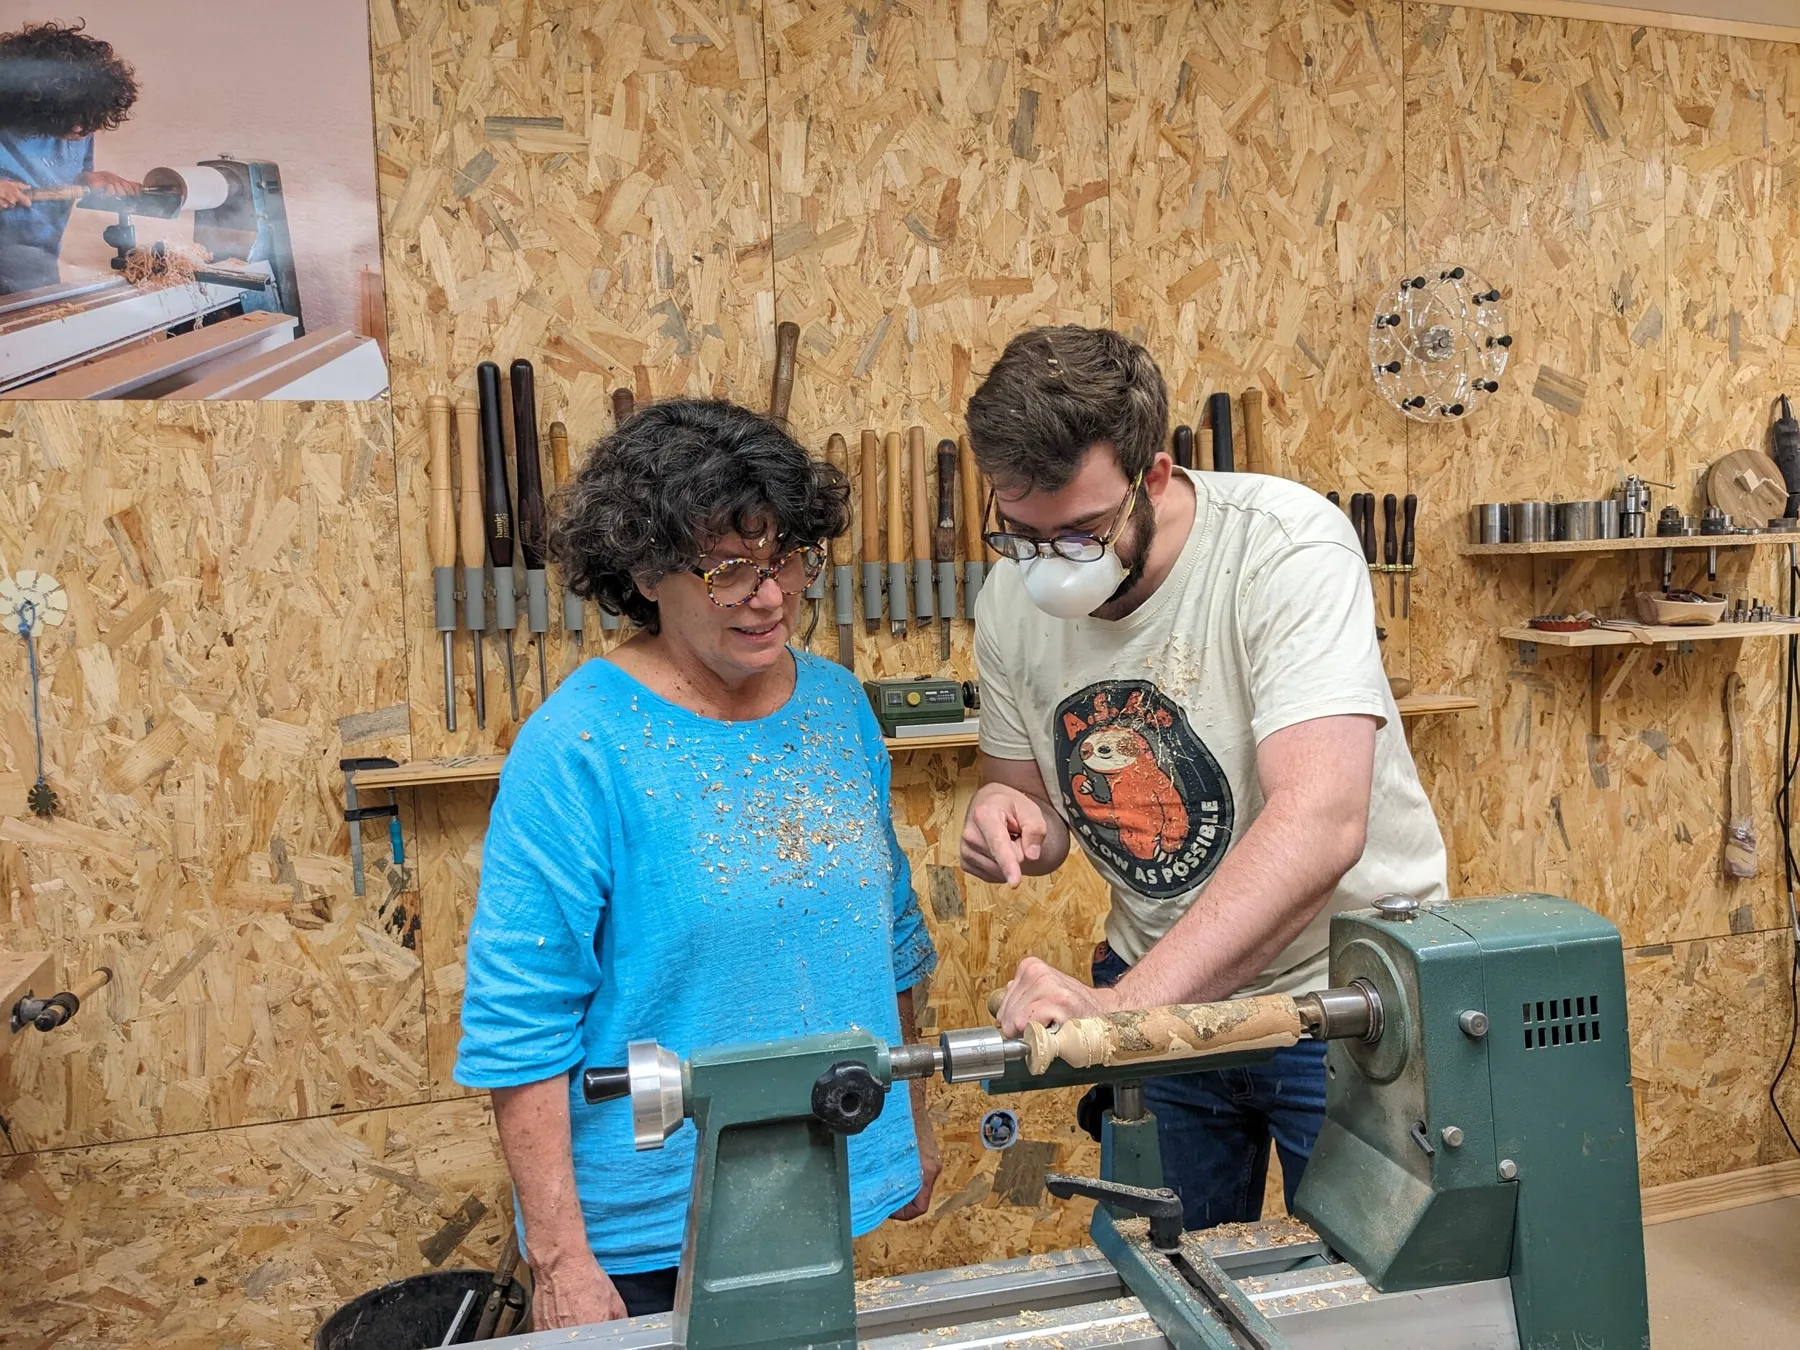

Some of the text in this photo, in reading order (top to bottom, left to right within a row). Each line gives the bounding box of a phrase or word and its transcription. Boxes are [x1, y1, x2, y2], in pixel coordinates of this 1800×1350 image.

[1079, 824, 1129, 871] SLOW
[1134, 866, 1158, 885] AS
[1161, 800, 1219, 884] POSSIBLE
